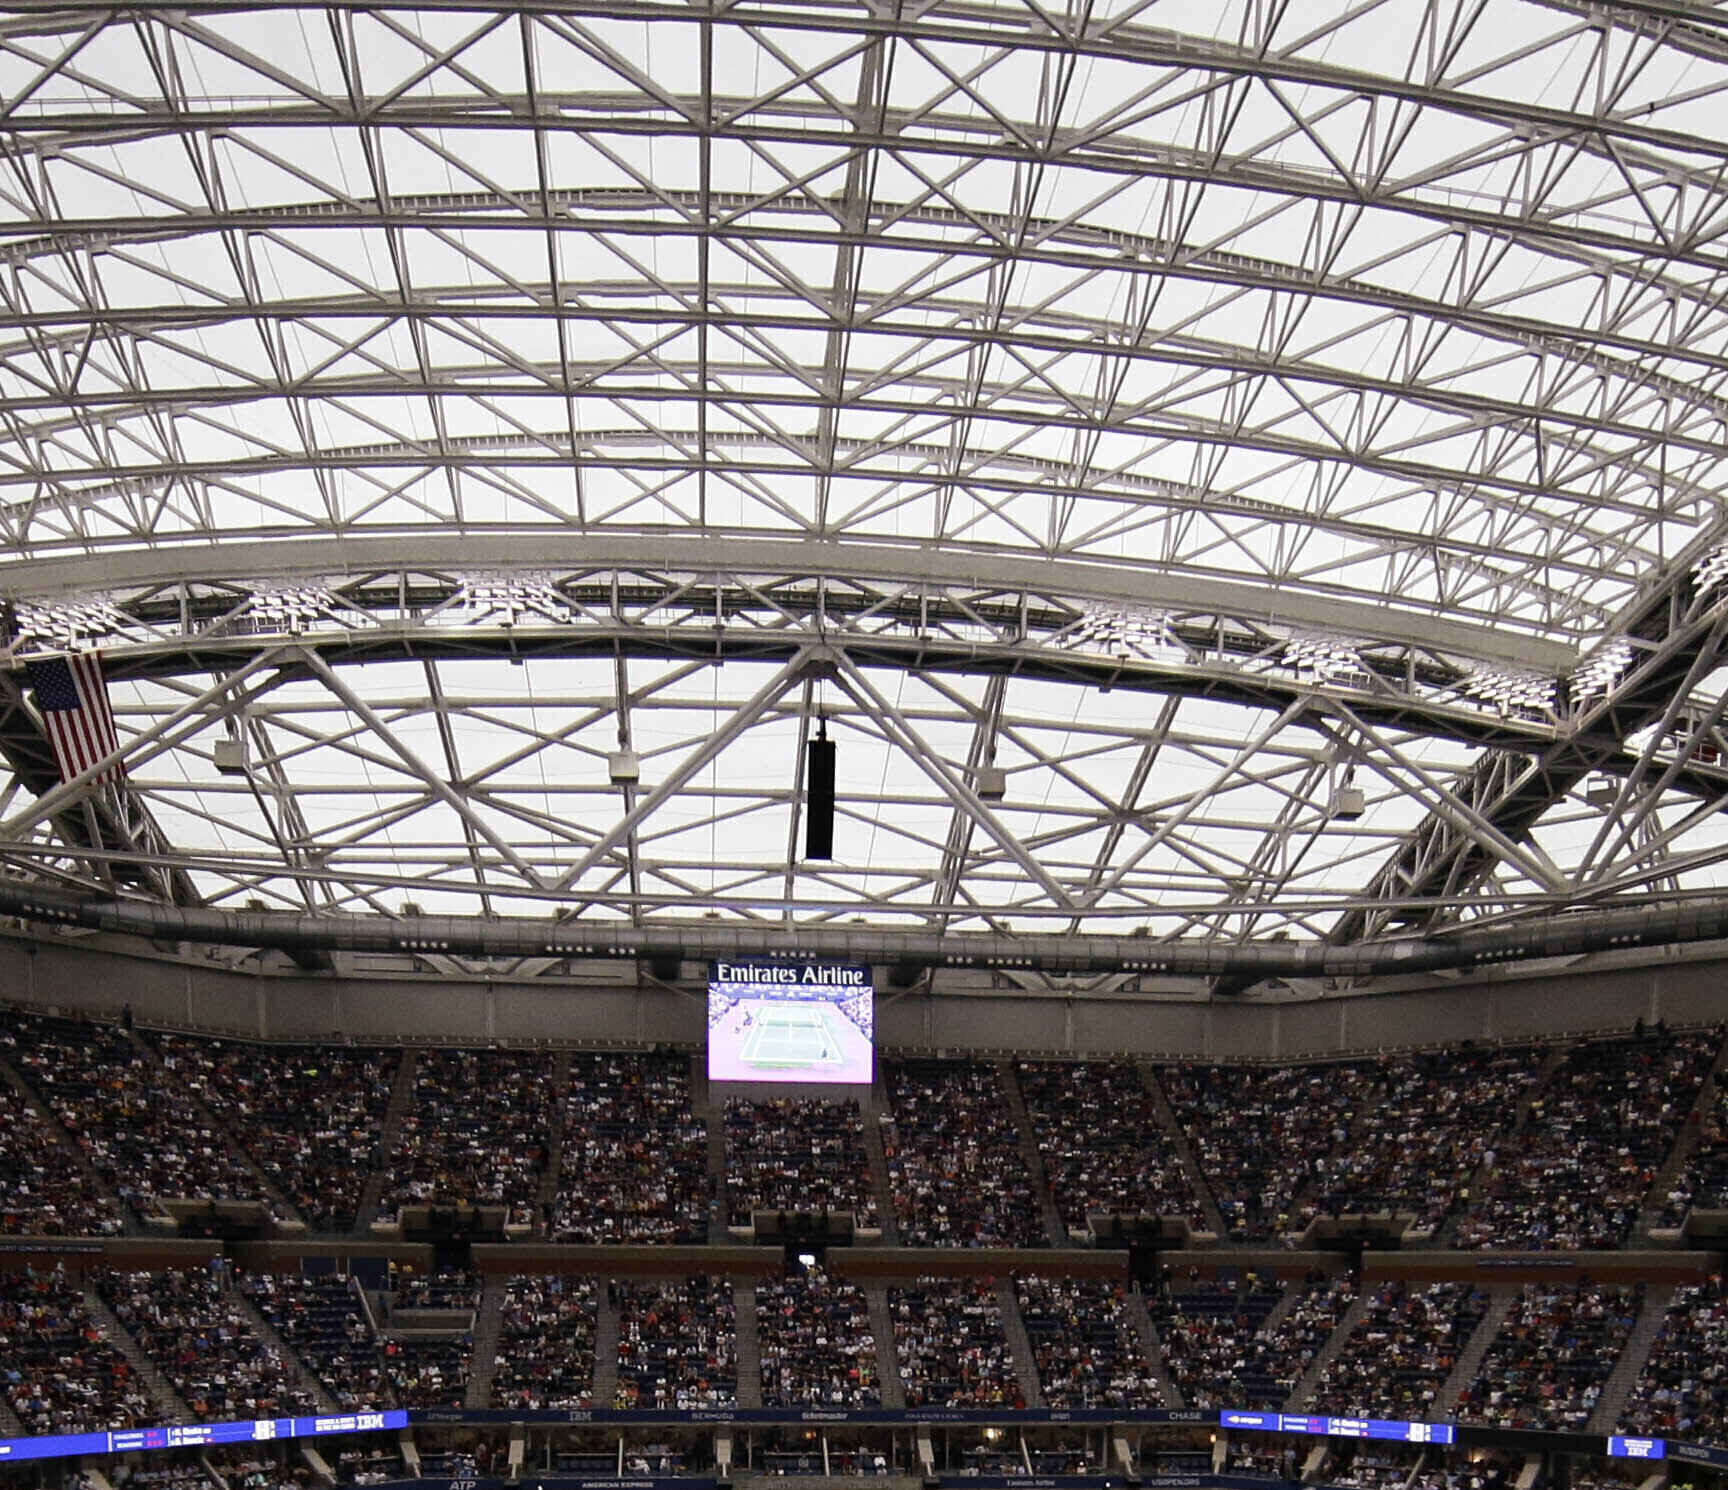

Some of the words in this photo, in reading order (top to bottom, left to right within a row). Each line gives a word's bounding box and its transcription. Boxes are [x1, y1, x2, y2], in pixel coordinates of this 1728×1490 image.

[717, 963, 797, 983] Emirates
[801, 966, 864, 985] Airline
[569, 1411, 592, 1422] IBM
[691, 1412, 735, 1420] BERMUDA
[1168, 1411, 1202, 1421] CHASE
[356, 1414, 384, 1430] IBM
[449, 1480, 477, 1490] ATP
[581, 1481, 619, 1489] AMERICAN
[620, 1481, 654, 1489] EXPRESS
